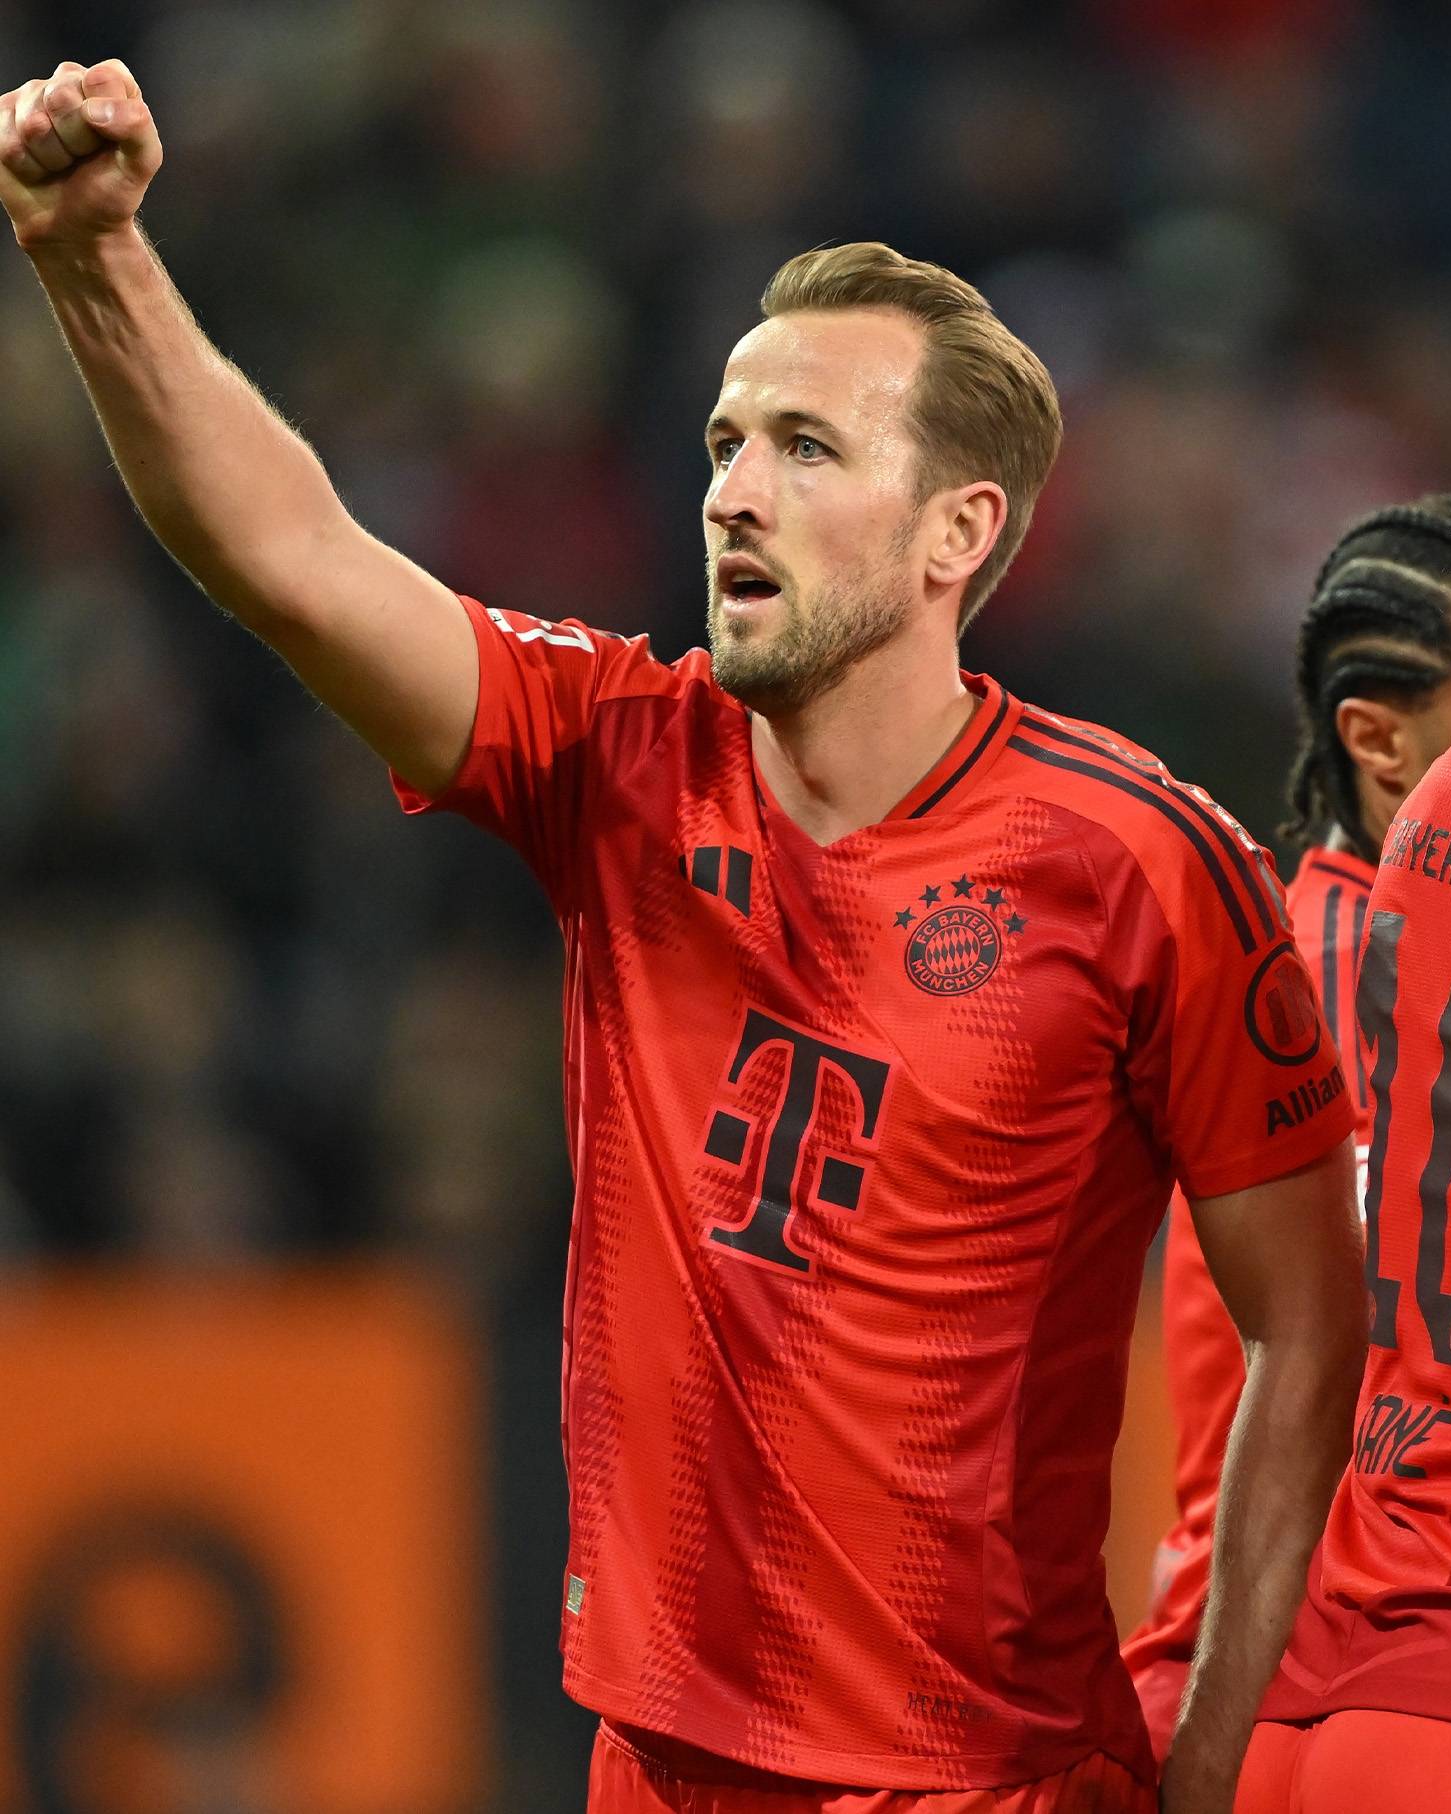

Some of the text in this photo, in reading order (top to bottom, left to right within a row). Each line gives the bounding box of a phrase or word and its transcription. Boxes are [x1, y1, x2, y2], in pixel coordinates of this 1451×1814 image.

[917, 911, 995, 946] FC BAYERN
[912, 959, 990, 990] MÜNCHEN
[1265, 1064, 1346, 1137] Allian
[704, 1007, 891, 1273] T
